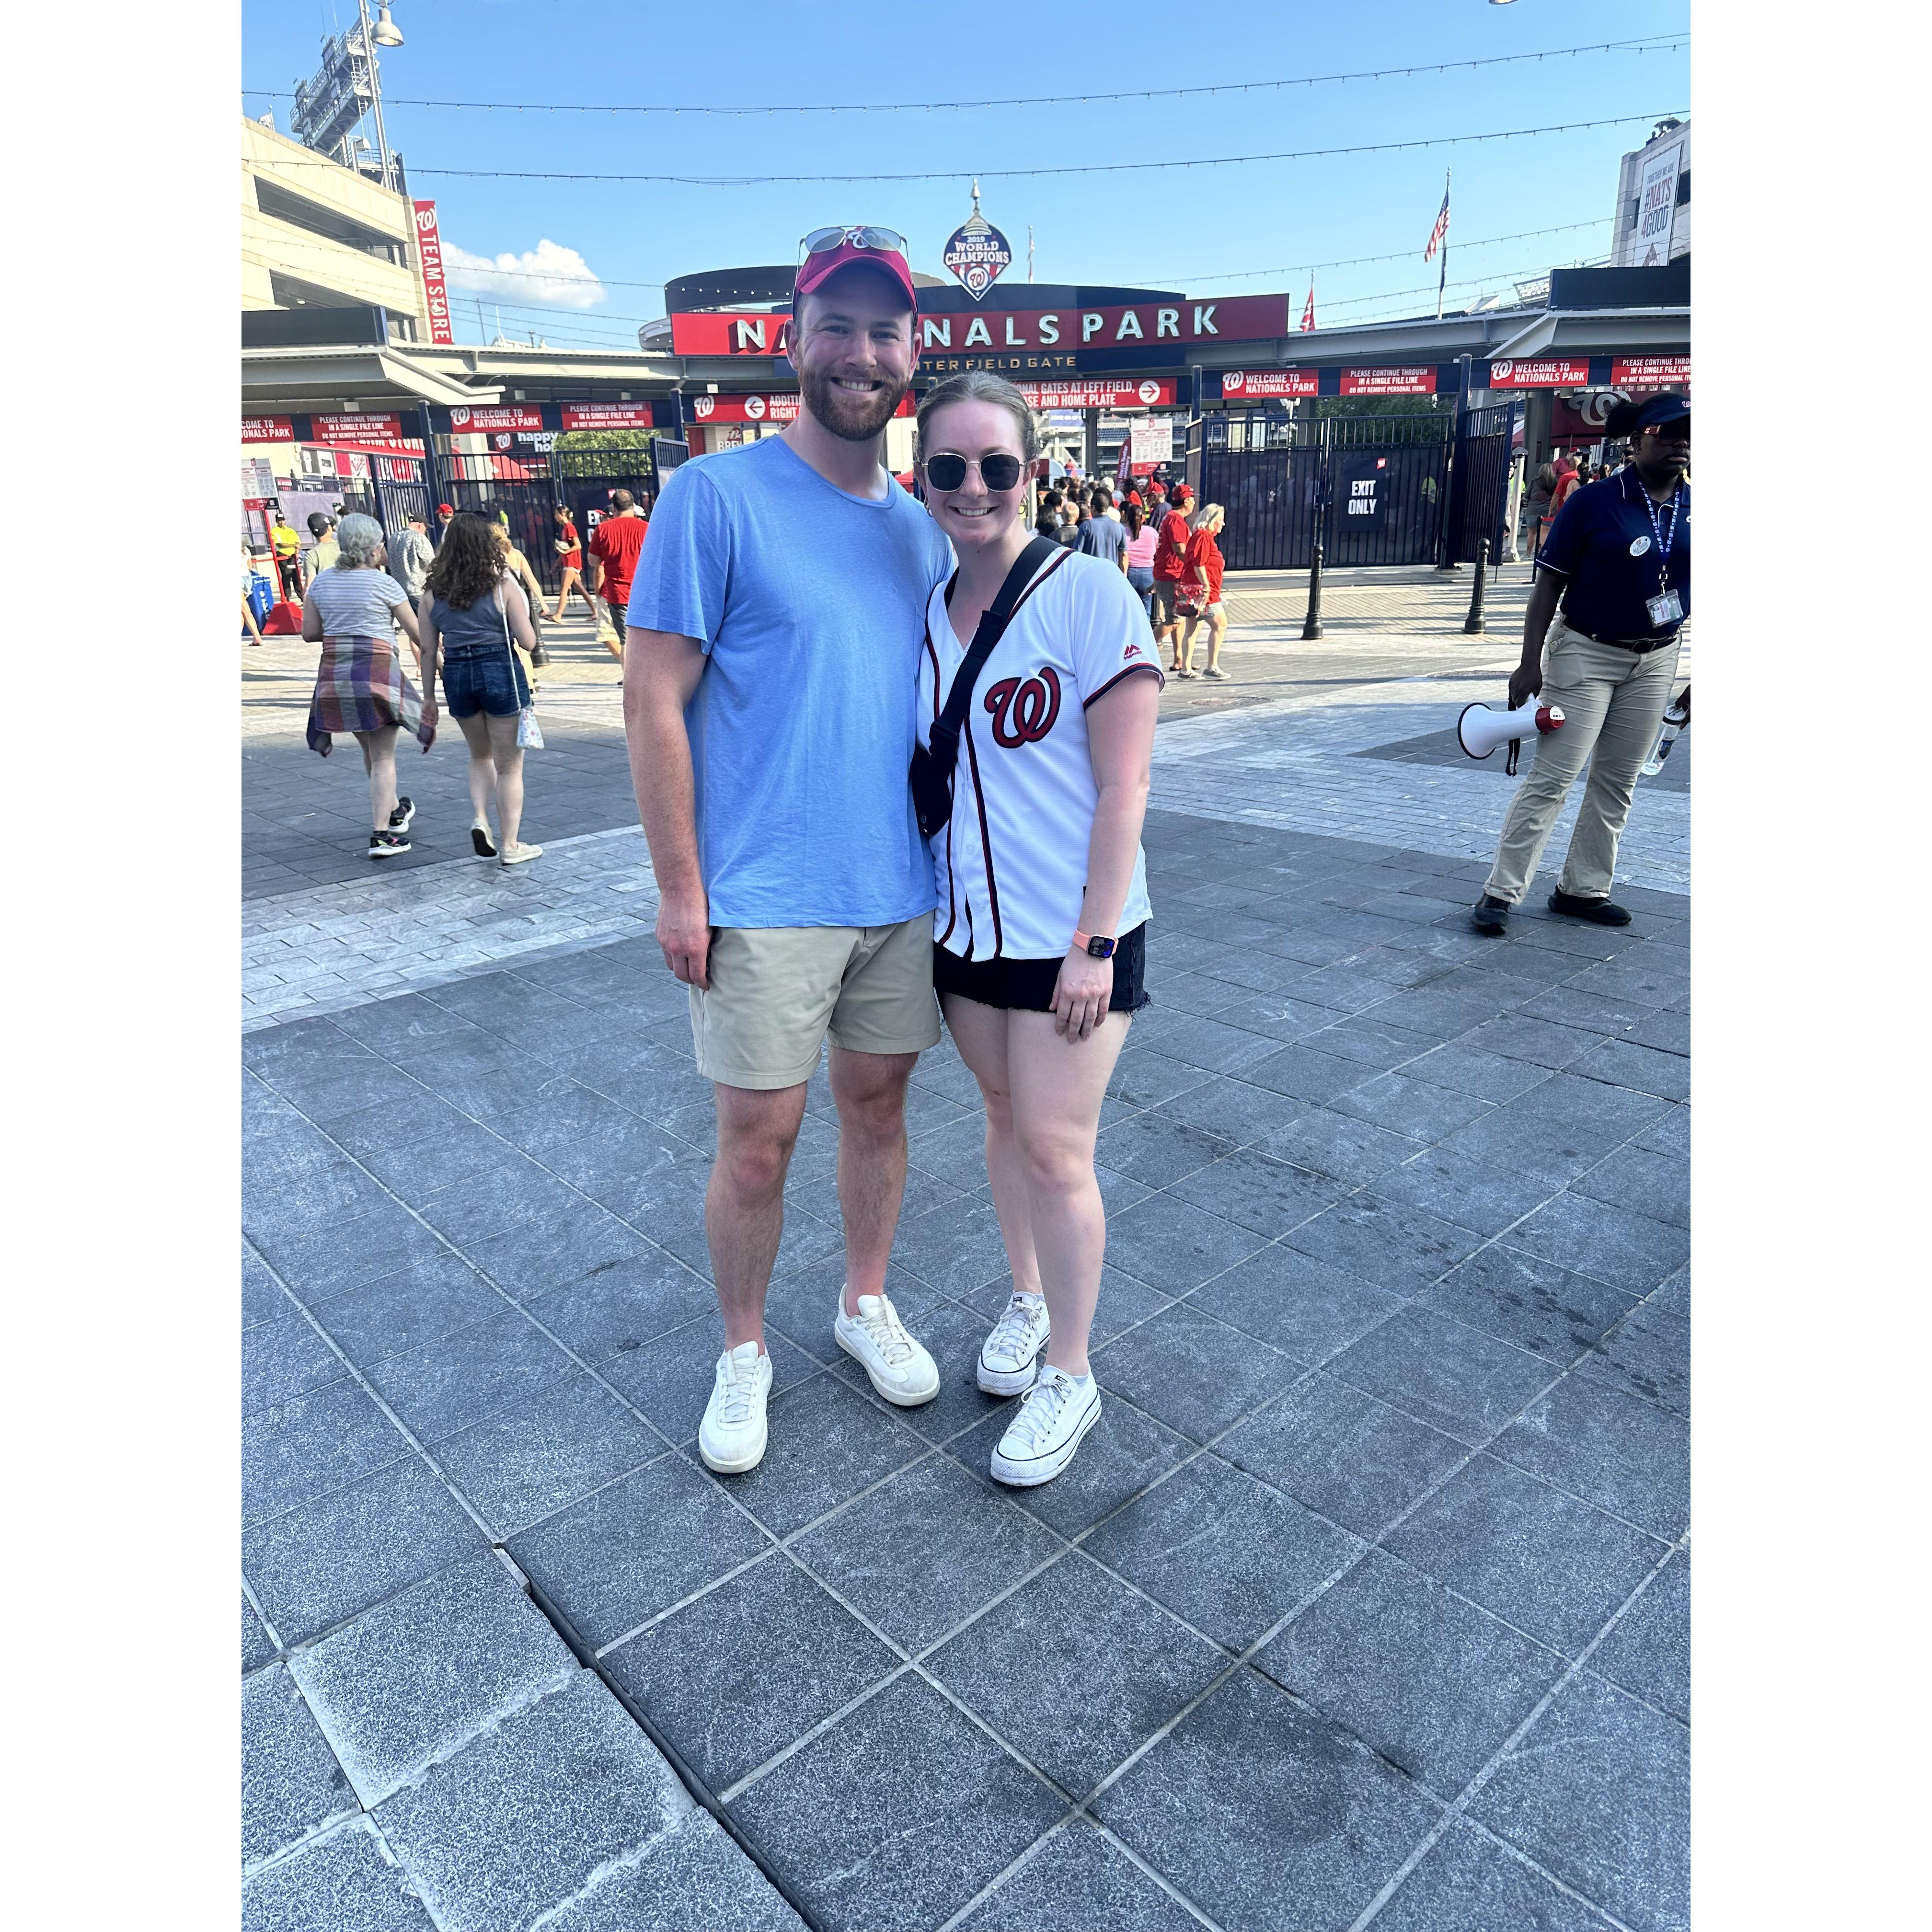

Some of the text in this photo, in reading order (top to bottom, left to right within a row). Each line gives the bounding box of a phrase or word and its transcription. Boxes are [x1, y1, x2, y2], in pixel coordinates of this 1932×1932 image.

[1644, 175, 1672, 212] #NATS
[1641, 205, 1668, 239] 4GOOD
[954, 241, 999, 252] WORLD
[422, 235, 442, 280] TEAM
[945, 252, 1009, 265] CHAMPIONS
[1082, 305, 1219, 342] PARK
[966, 358, 1021, 370] FIELD
[1027, 357, 1076, 368] GATE
[1515, 363, 1570, 373] WELCOME TO
[1246, 374, 1300, 384] WELCOME TO
[1514, 372, 1585, 383] NATIONALS PARK
[1041, 383, 1069, 394] GATES
[1070, 382, 1081, 393] AT
[1083, 381, 1104, 393] LEFT
[1106, 381, 1135, 394] FIELD,
[1246, 382, 1315, 394] NATIONALS PARK
[1041, 395, 1059, 407] AND
[1061, 394, 1087, 406] HOME
[1089, 393, 1116, 405] PLATE
[472, 409, 523, 419] WELCOME TO
[770, 407, 797, 419] RIGHT
[264, 420, 274, 428] TO
[473, 417, 540, 428] NATIONALS PARK
[269, 428, 290, 437] PARK
[518, 432, 559, 443] happy
[1351, 480, 1376, 496] EXIT
[1348, 499, 1377, 515] ONLY
